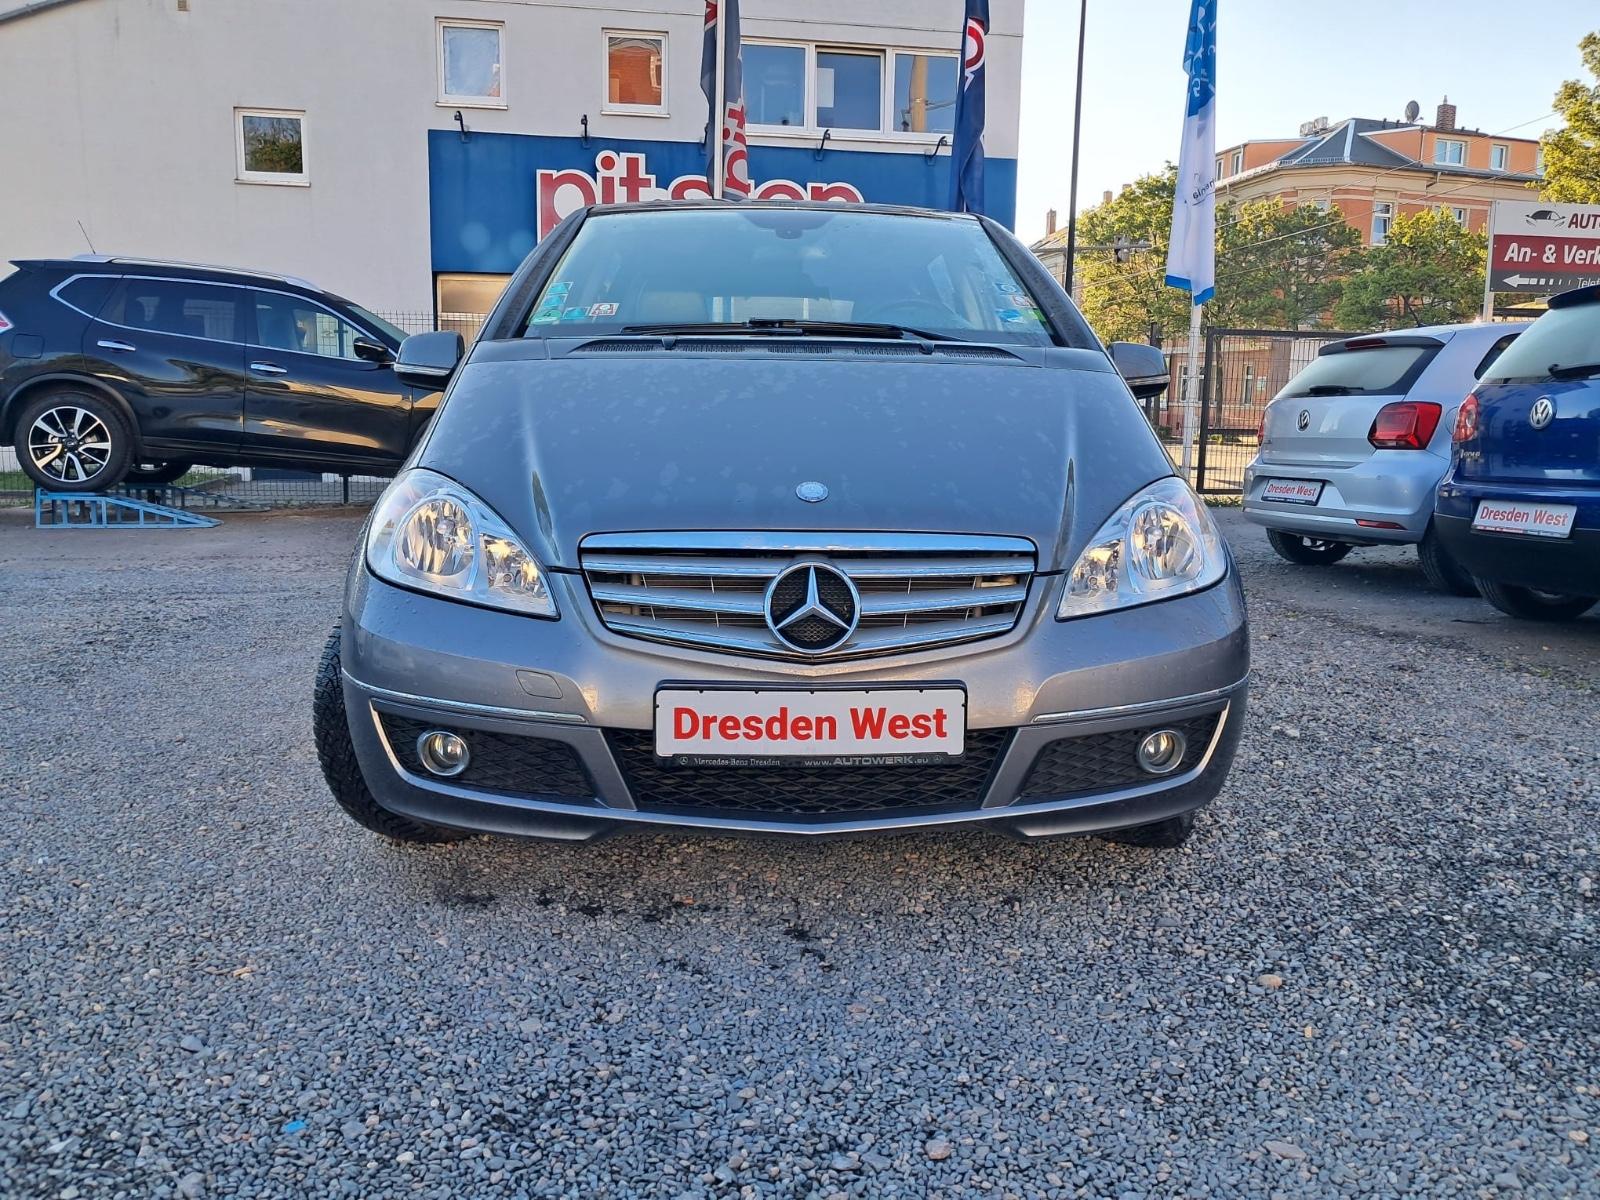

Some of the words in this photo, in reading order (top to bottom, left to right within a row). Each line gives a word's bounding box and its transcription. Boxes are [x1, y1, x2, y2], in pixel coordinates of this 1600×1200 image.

[1568, 213, 1600, 229] AUT
[1504, 243, 1537, 262] An-
[1543, 244, 1556, 263] &
[1267, 484, 1295, 494] Dresden
[1297, 486, 1316, 497] West
[1480, 506, 1529, 523] Dresden
[1534, 509, 1568, 526] West
[674, 706, 837, 741] Dresden
[850, 707, 947, 739] West
